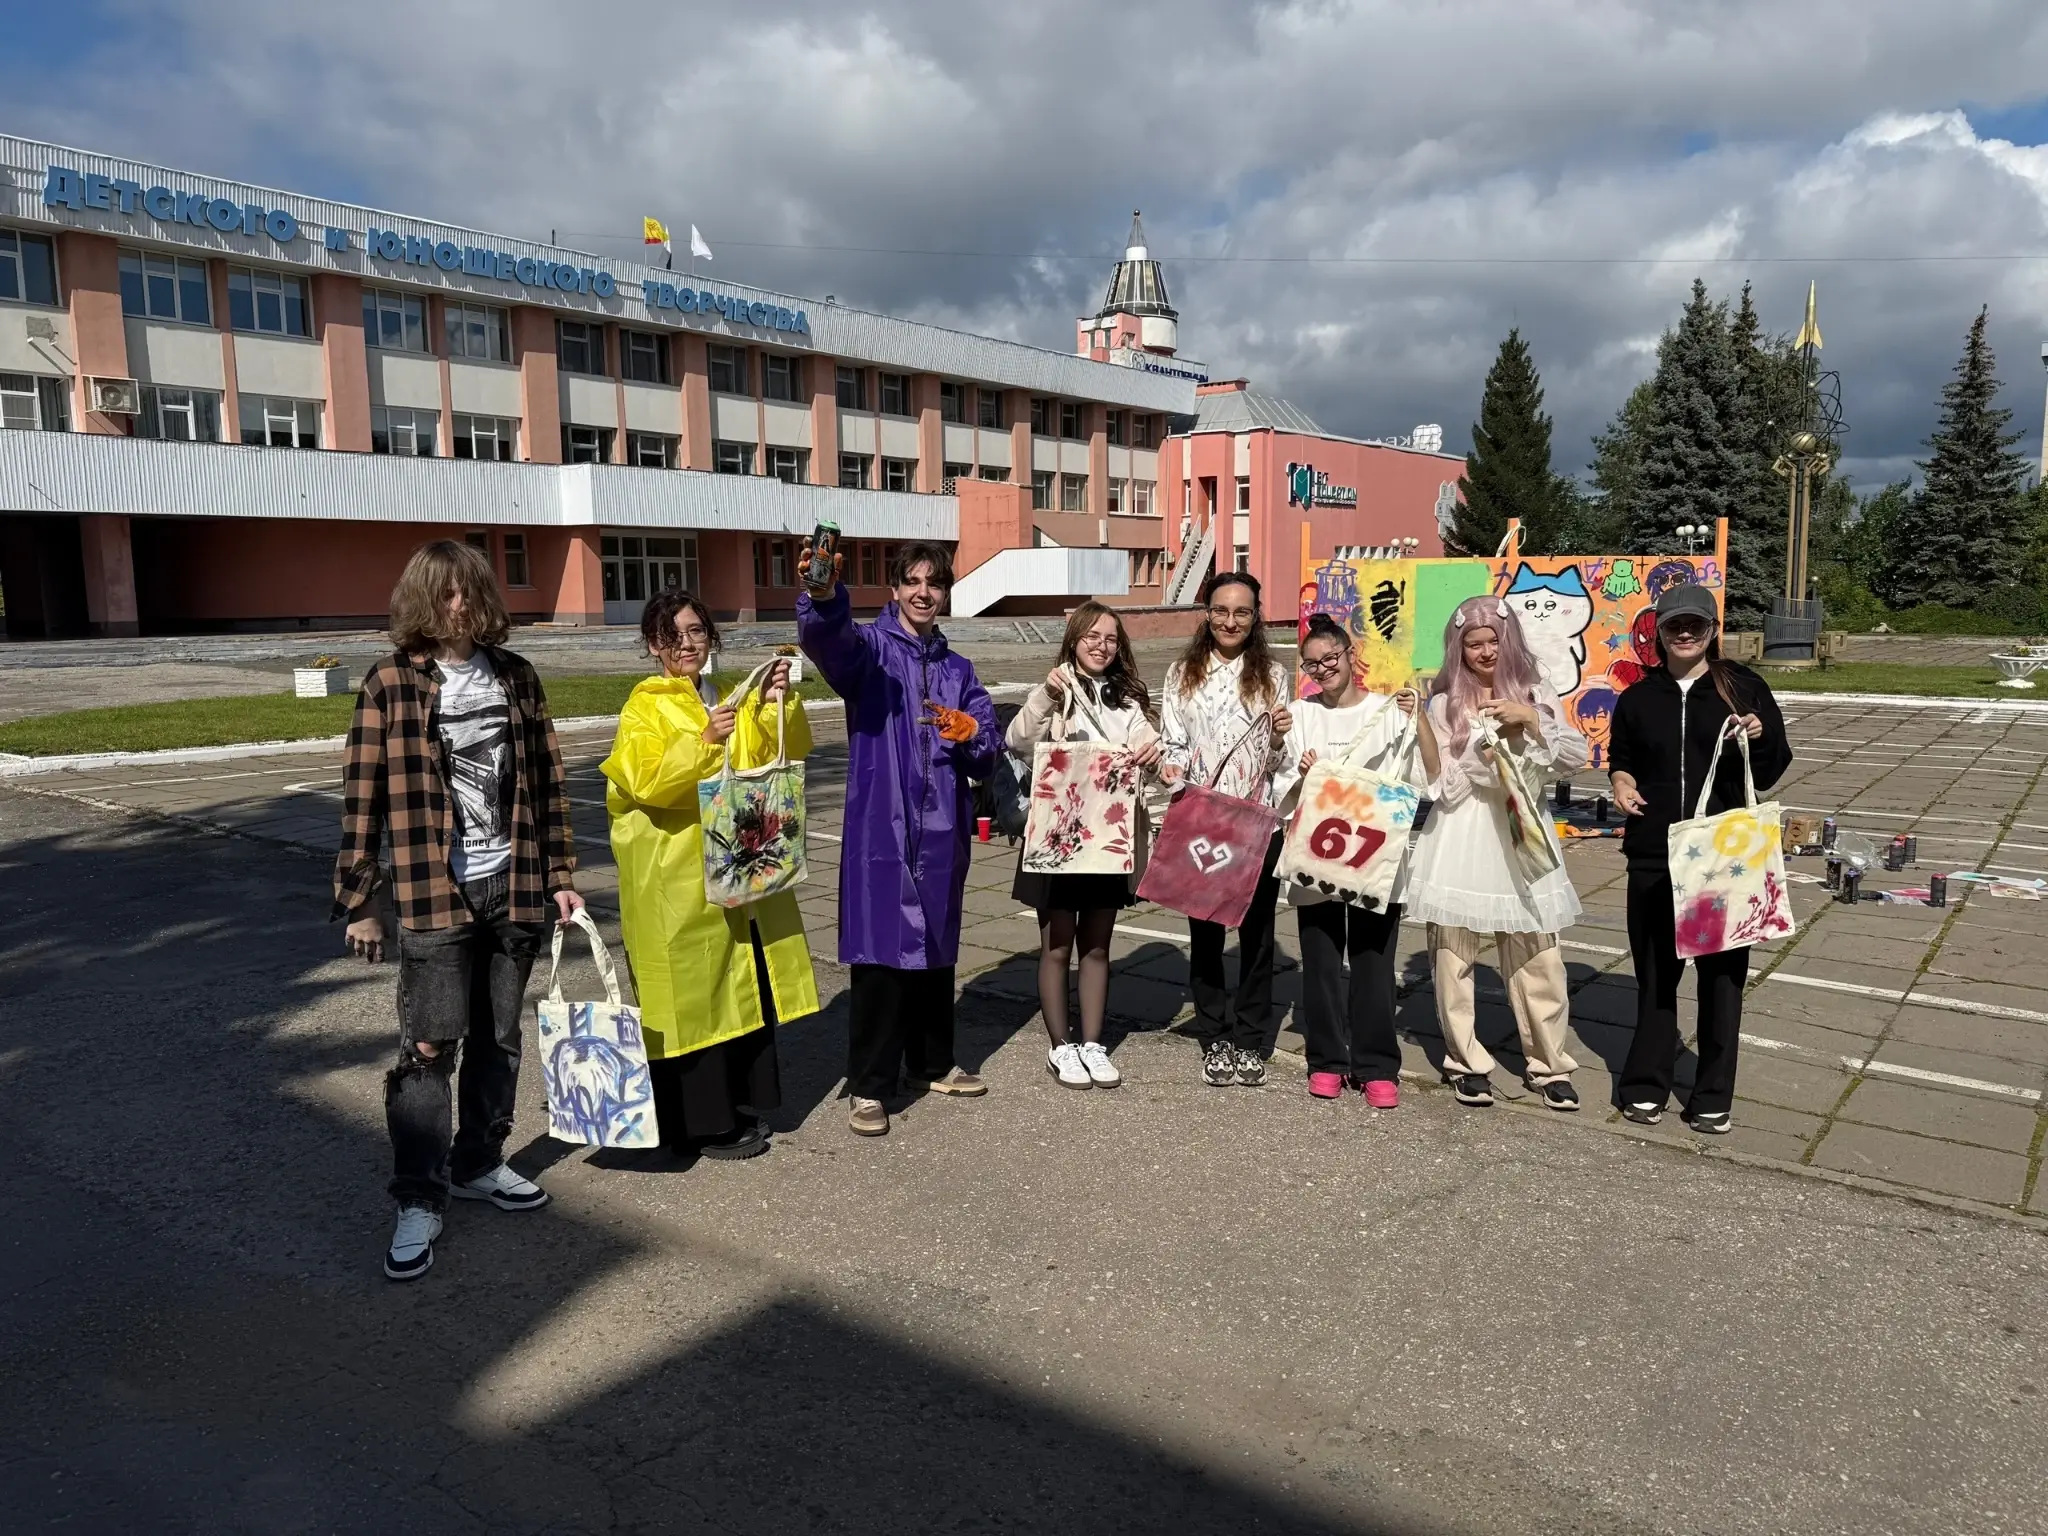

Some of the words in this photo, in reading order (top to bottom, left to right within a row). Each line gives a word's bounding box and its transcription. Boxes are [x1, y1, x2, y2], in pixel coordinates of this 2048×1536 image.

[42, 165, 297, 242] ДЕТСКОГО
[366, 227, 616, 299] ЮНОШЕСКОГО
[642, 280, 809, 335] ТВОРЧЕСТВА
[1310, 818, 1387, 869] 67
